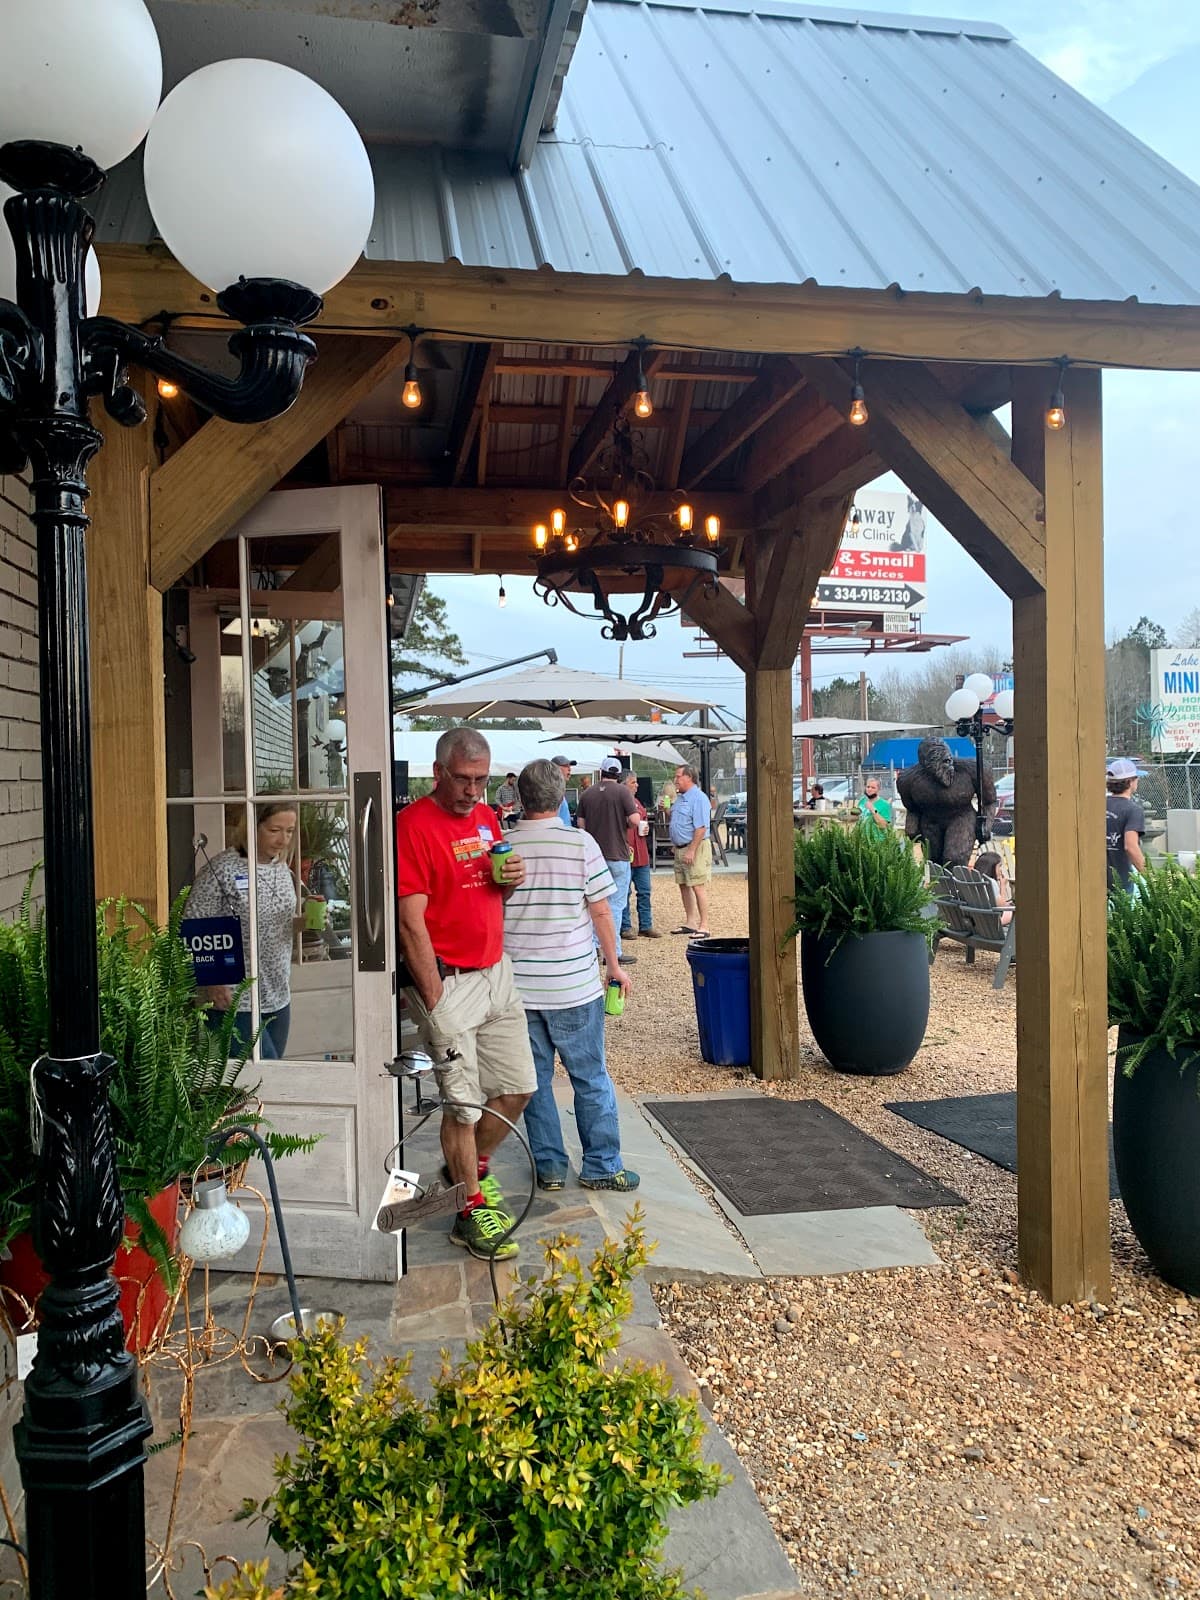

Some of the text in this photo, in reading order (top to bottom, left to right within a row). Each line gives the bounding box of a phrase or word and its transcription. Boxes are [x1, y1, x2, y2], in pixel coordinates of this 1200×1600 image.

[862, 528, 896, 542] Clinic
[839, 552, 914, 568] & Small
[844, 567, 904, 579] Services
[834, 587, 910, 603] 334-918-2130
[1164, 671, 1199, 694] MINI
[182, 934, 234, 952] LOSED
[195, 955, 215, 963] BACK
